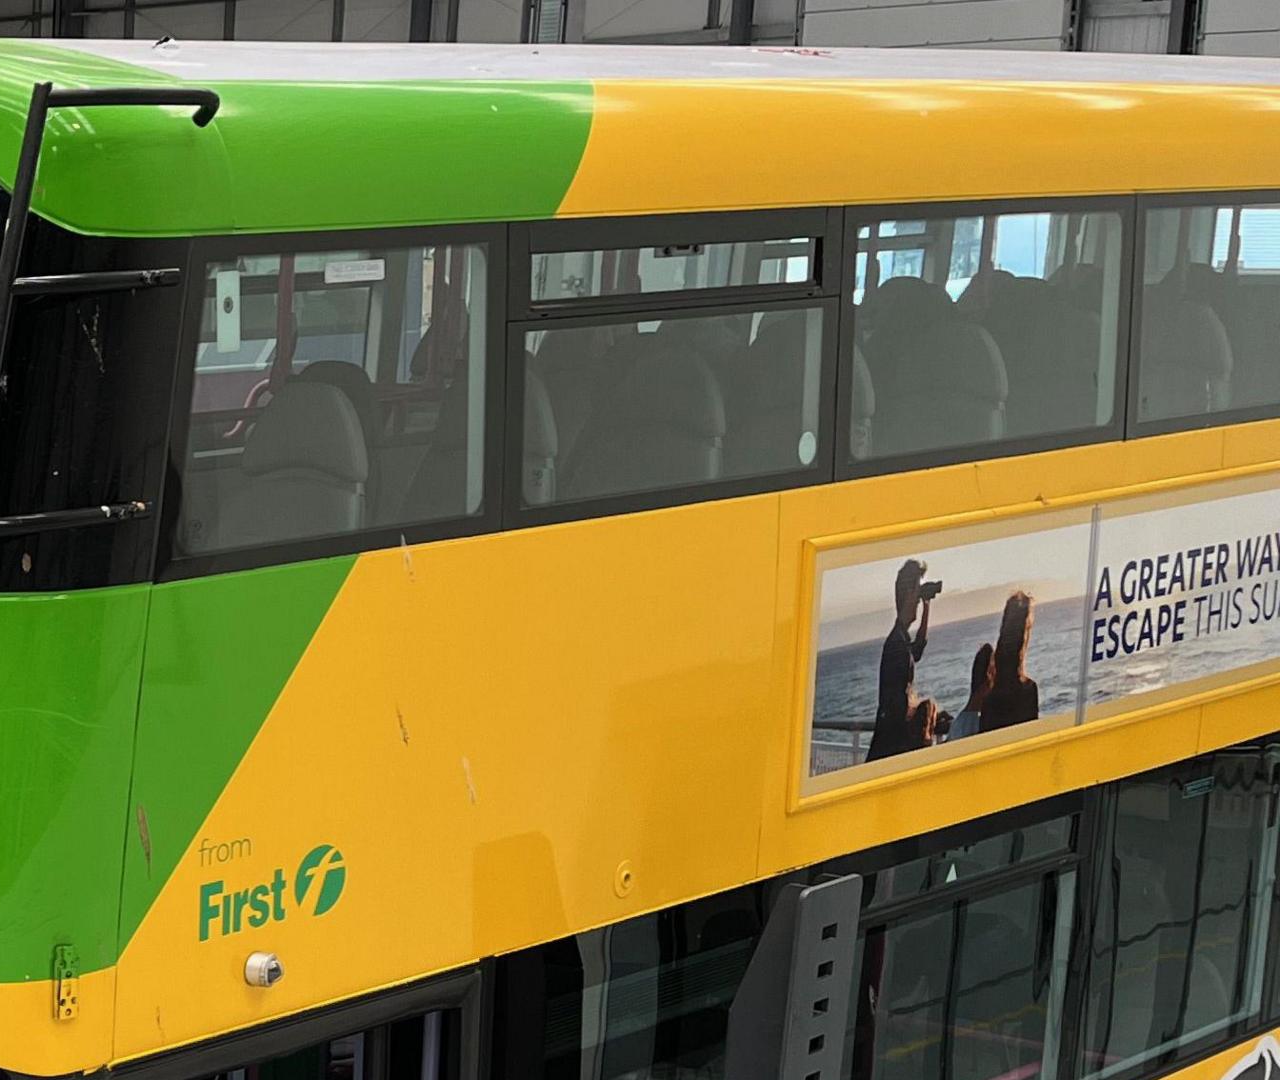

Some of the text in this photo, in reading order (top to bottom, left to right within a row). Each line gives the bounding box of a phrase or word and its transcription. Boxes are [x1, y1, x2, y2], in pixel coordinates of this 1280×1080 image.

[1093, 567, 1113, 611] A
[1120, 543, 1230, 605] GREATER
[1091, 579, 1280, 663] ESCAPE THIS SU
[198, 838, 252, 867] from
[199, 868, 287, 942] First
